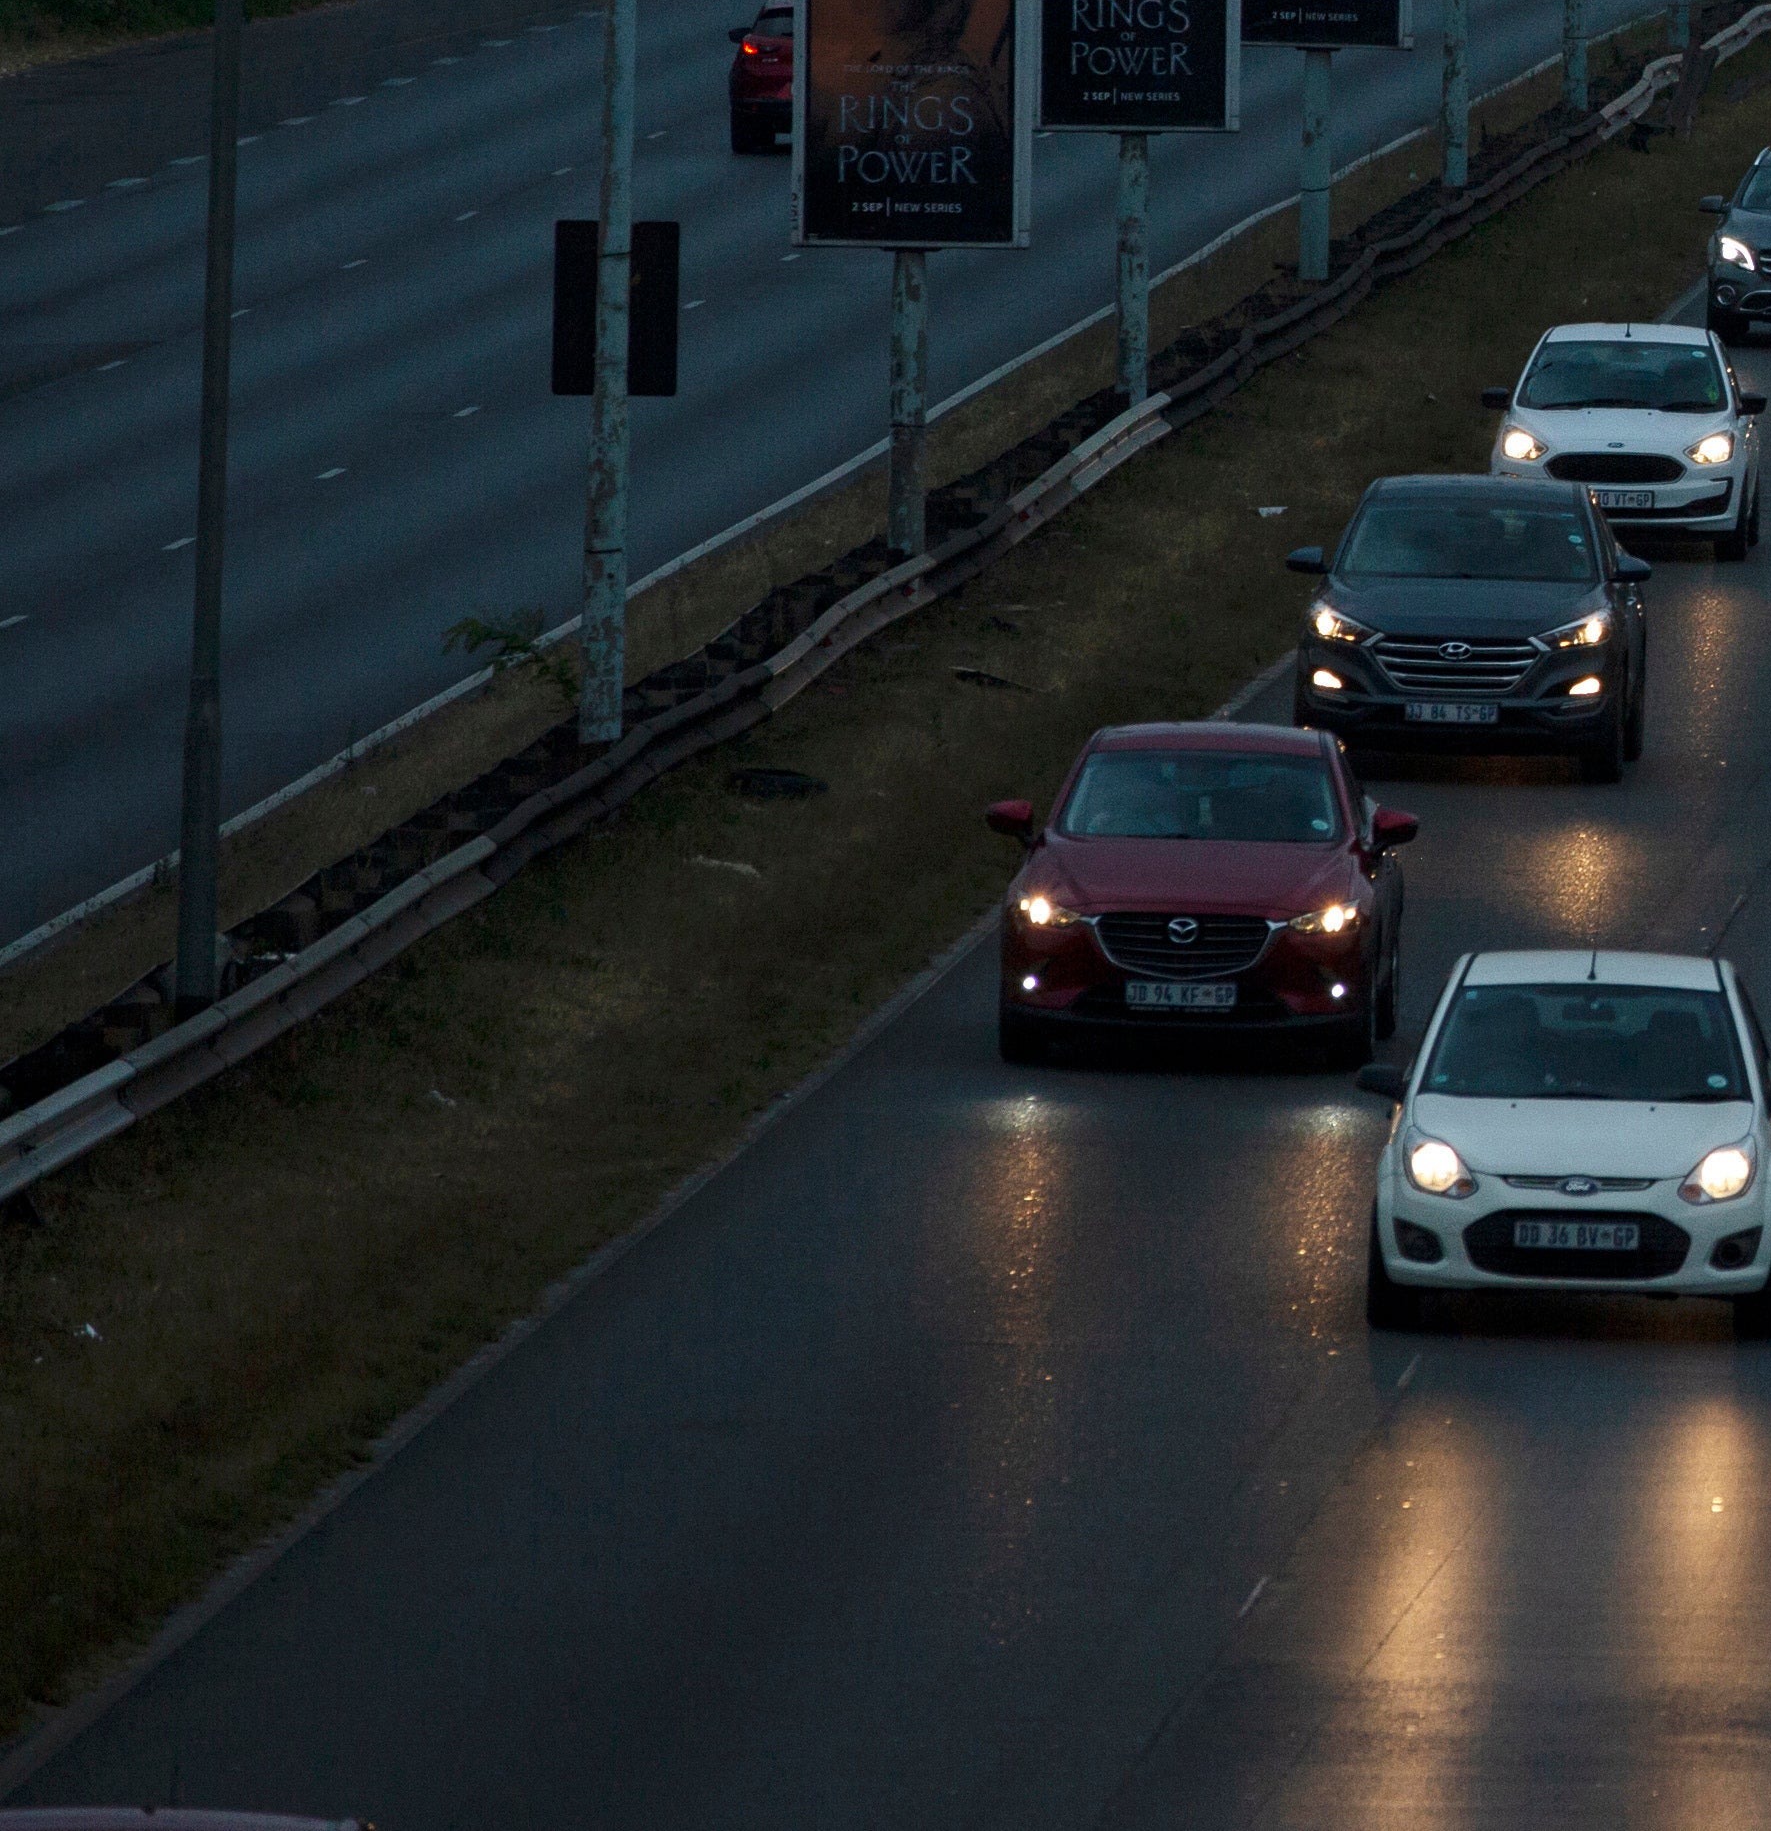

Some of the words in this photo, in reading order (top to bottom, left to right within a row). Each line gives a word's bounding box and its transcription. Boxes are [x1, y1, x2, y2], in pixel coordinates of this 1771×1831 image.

[1272, 11, 1278, 19] 2
[1279, 11, 1297, 20] SEP
[1305, 12, 1326, 21] NEW
[1327, 12, 1359, 22] SERIES
[1120, 31, 1136, 42] OF
[1071, 41, 1194, 76] POWER
[865, 64, 894, 75] LORD
[896, 64, 910, 74] OF
[914, 64, 933, 74] THE
[891, 81, 917, 93] THE
[1082, 91, 1090, 101] 2
[1091, 91, 1111, 102] SEP
[1120, 91, 1144, 102] NEW
[1146, 92, 1180, 102] SERIES
[839, 94, 974, 137] RINGS
[894, 133, 912, 145] OF
[838, 144, 978, 184] POWER
[851, 201, 861, 213] 2
[862, 201, 884, 213] SEP
[894, 202, 921, 214] NEW
[923, 202, 963, 214] SERIES
[1614, 491, 1626, 505] VT
[1636, 492, 1649, 506] GP
[1456, 706, 1471, 720] TS
[1479, 706, 1495, 721] GP
[1153, 985, 1173, 1003] 94
[1180, 986, 1200, 1003] KF
[1214, 987, 1233, 1004] GP
[1548, 1226, 1569, 1244] 36
[1577, 1227, 1599, 1245] BV
[1613, 1228, 1635, 1247] GP
